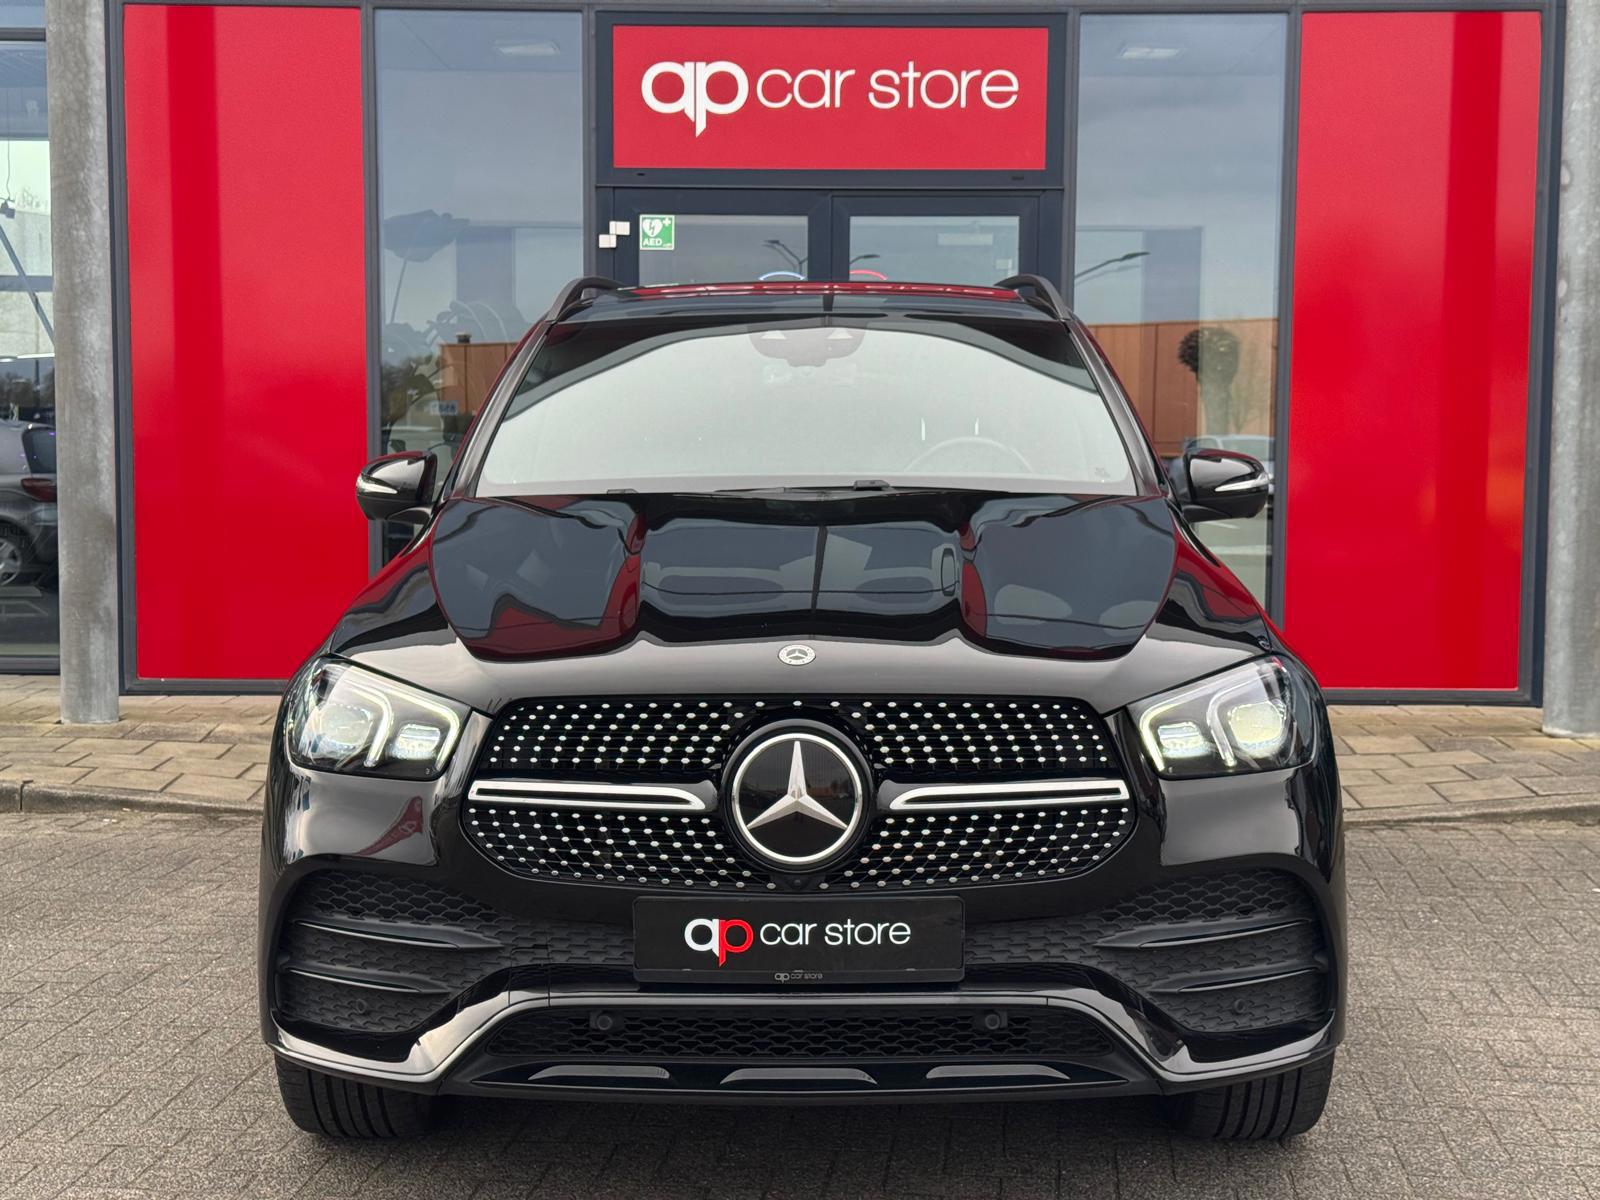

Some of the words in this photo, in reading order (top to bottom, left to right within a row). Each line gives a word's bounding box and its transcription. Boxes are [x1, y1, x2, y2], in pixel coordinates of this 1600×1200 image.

[640, 60, 749, 138] ap
[756, 68, 856, 109] car
[868, 61, 1019, 110] store
[642, 238, 662, 246] AED
[684, 918, 754, 968] ap
[759, 922, 817, 946] car
[824, 918, 911, 946] store
[774, 972, 790, 984] ap
